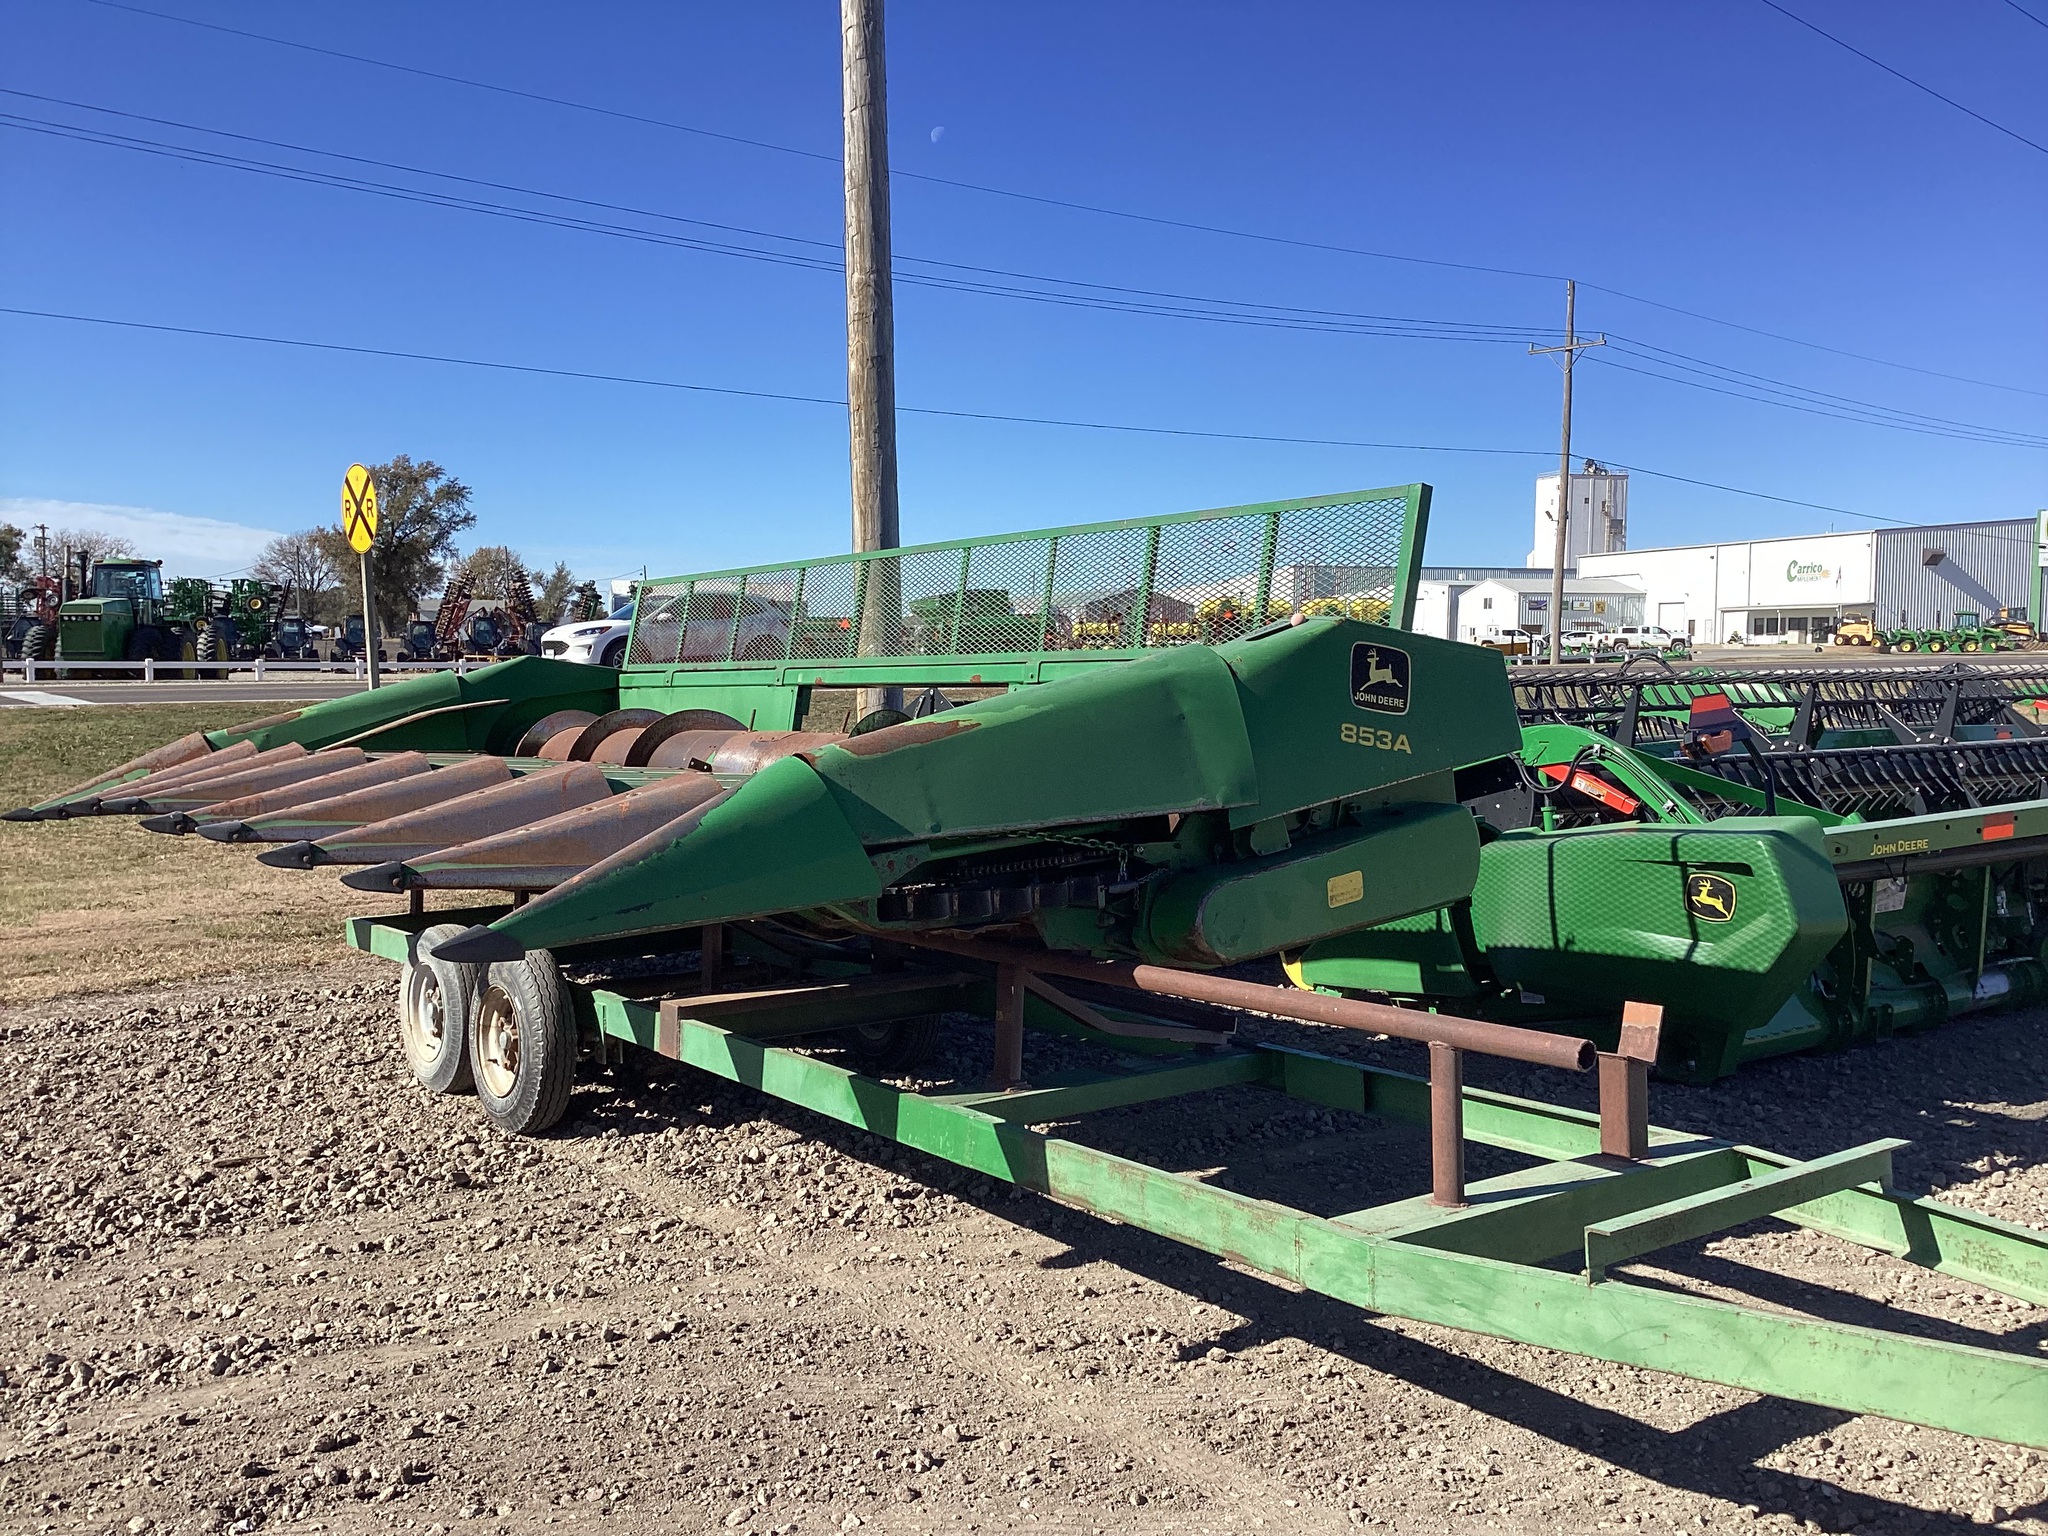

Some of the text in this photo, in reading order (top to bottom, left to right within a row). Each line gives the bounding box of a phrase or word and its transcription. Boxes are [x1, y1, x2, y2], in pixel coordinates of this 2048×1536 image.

[345, 498, 374, 518] R R
[1787, 560, 1823, 582] Carrico
[1354, 691, 1405, 708] JOHN DEERE
[1340, 723, 1412, 755] 853A
[1870, 839, 1929, 856] JOHN DEERE
